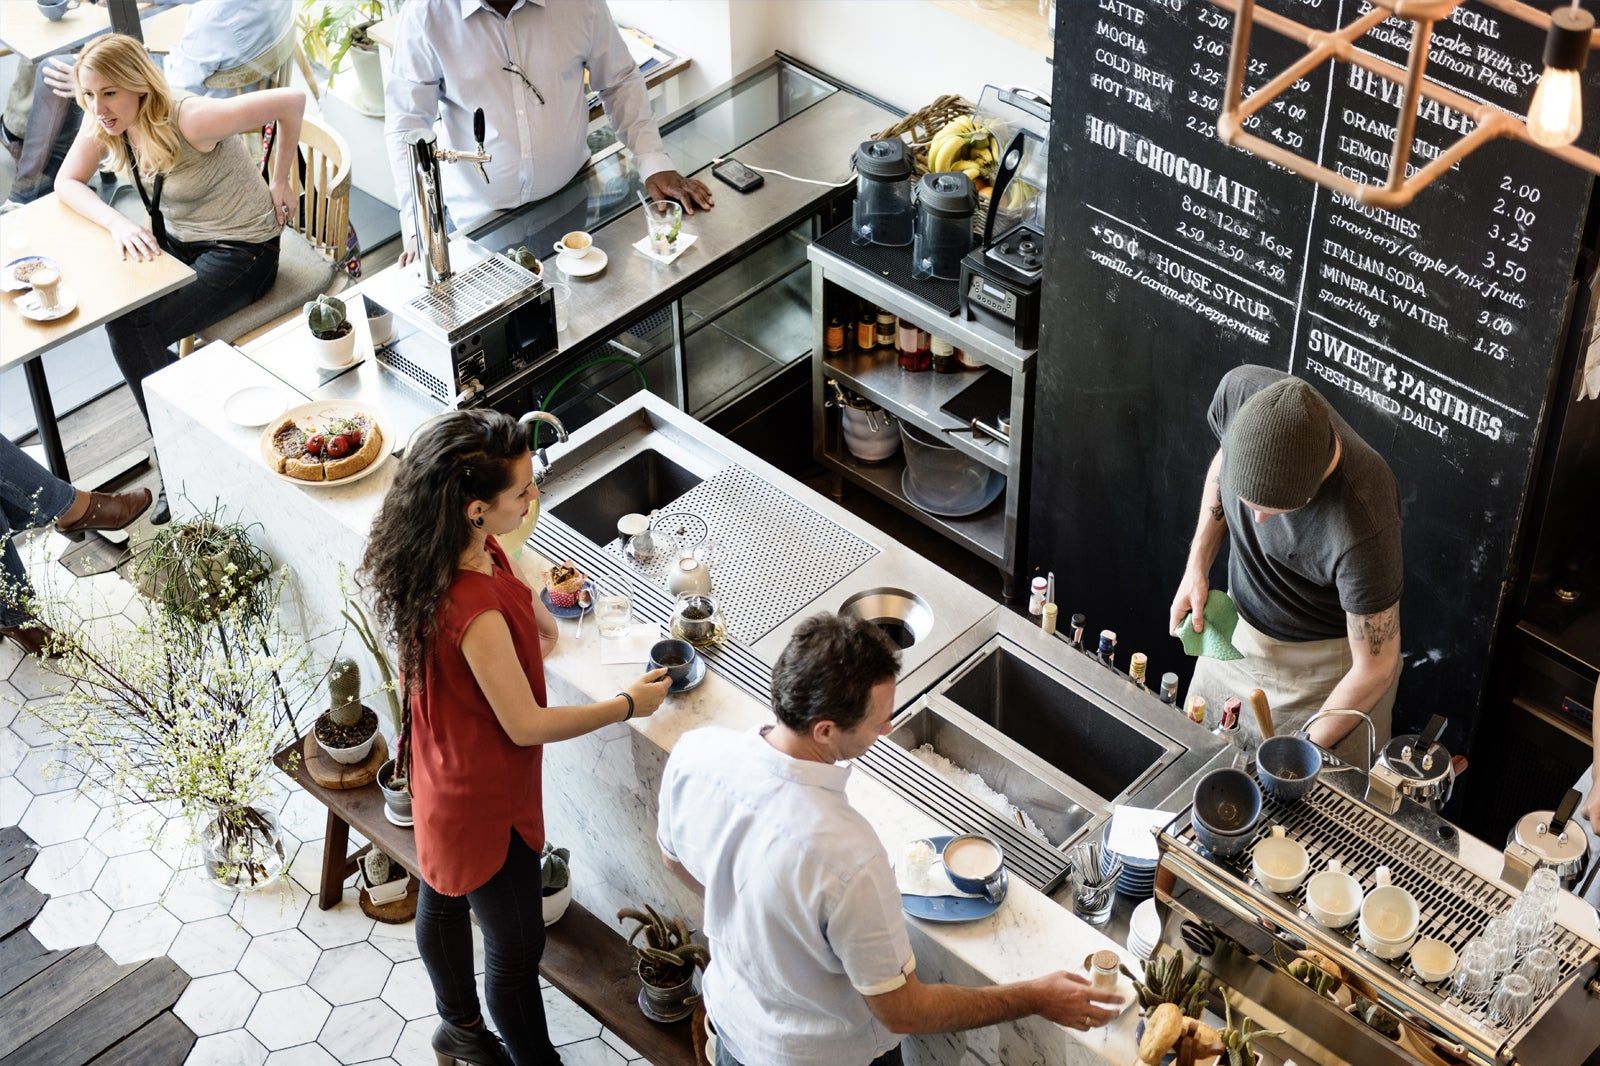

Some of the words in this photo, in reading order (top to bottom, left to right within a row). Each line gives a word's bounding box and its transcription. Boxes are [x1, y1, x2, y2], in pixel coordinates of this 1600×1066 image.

[1098, 0, 1145, 25] LATTE
[1193, 35, 1224, 56] 3.00
[1198, 8, 1228, 30] 2.50
[1443, 6, 1500, 39] ECIAL
[1095, 48, 1130, 74] COLD
[1133, 63, 1174, 94] BREW
[1188, 90, 1218, 111] 2.50
[1096, 19, 1147, 54] MOCHA
[1190, 62, 1221, 85] 3.25
[1274, 101, 1307, 121] 4.00
[1427, 44, 1474, 78] almon
[1477, 65, 1518, 95] Plate
[1477, 45, 1515, 76] With
[1093, 73, 1122, 97] HOT
[1125, 87, 1154, 112] TEA
[1186, 116, 1216, 138] 2.25
[1089, 115, 1130, 157] HOT
[1135, 139, 1258, 216] CHOCOLATE
[1343, 109, 1399, 143] ORANG
[1500, 175, 1540, 203] 2.00
[1217, 212, 1250, 239] 12oz
[1260, 231, 1293, 260] 16oz
[1331, 189, 1420, 238] SMOOTHIES
[1481, 251, 1527, 283] 3.50
[1335, 161, 1368, 187] ICED
[1488, 224, 1533, 252] 3.25
[1493, 198, 1536, 226] 2.00
[1217, 240, 1245, 261] 3.50
[1323, 239, 1385, 277] ITALIAN
[1385, 266, 1426, 298] SODA
[1156, 253, 1212, 295] HOUSE
[1213, 283, 1270, 320] SYRUP
[1318, 288, 1381, 328] sparkling
[1322, 263, 1389, 306] MINERAL
[1391, 294, 1449, 335] WATER
[1473, 337, 1508, 361] 1.75
[1481, 282, 1526, 309] fruits
[1305, 357, 1352, 391] FRESH
[1351, 380, 1401, 414] BAKED
[1401, 405, 1449, 438] DAILY
[1308, 329, 1387, 382] SWEET
[1398, 371, 1503, 441] PASTRIES
